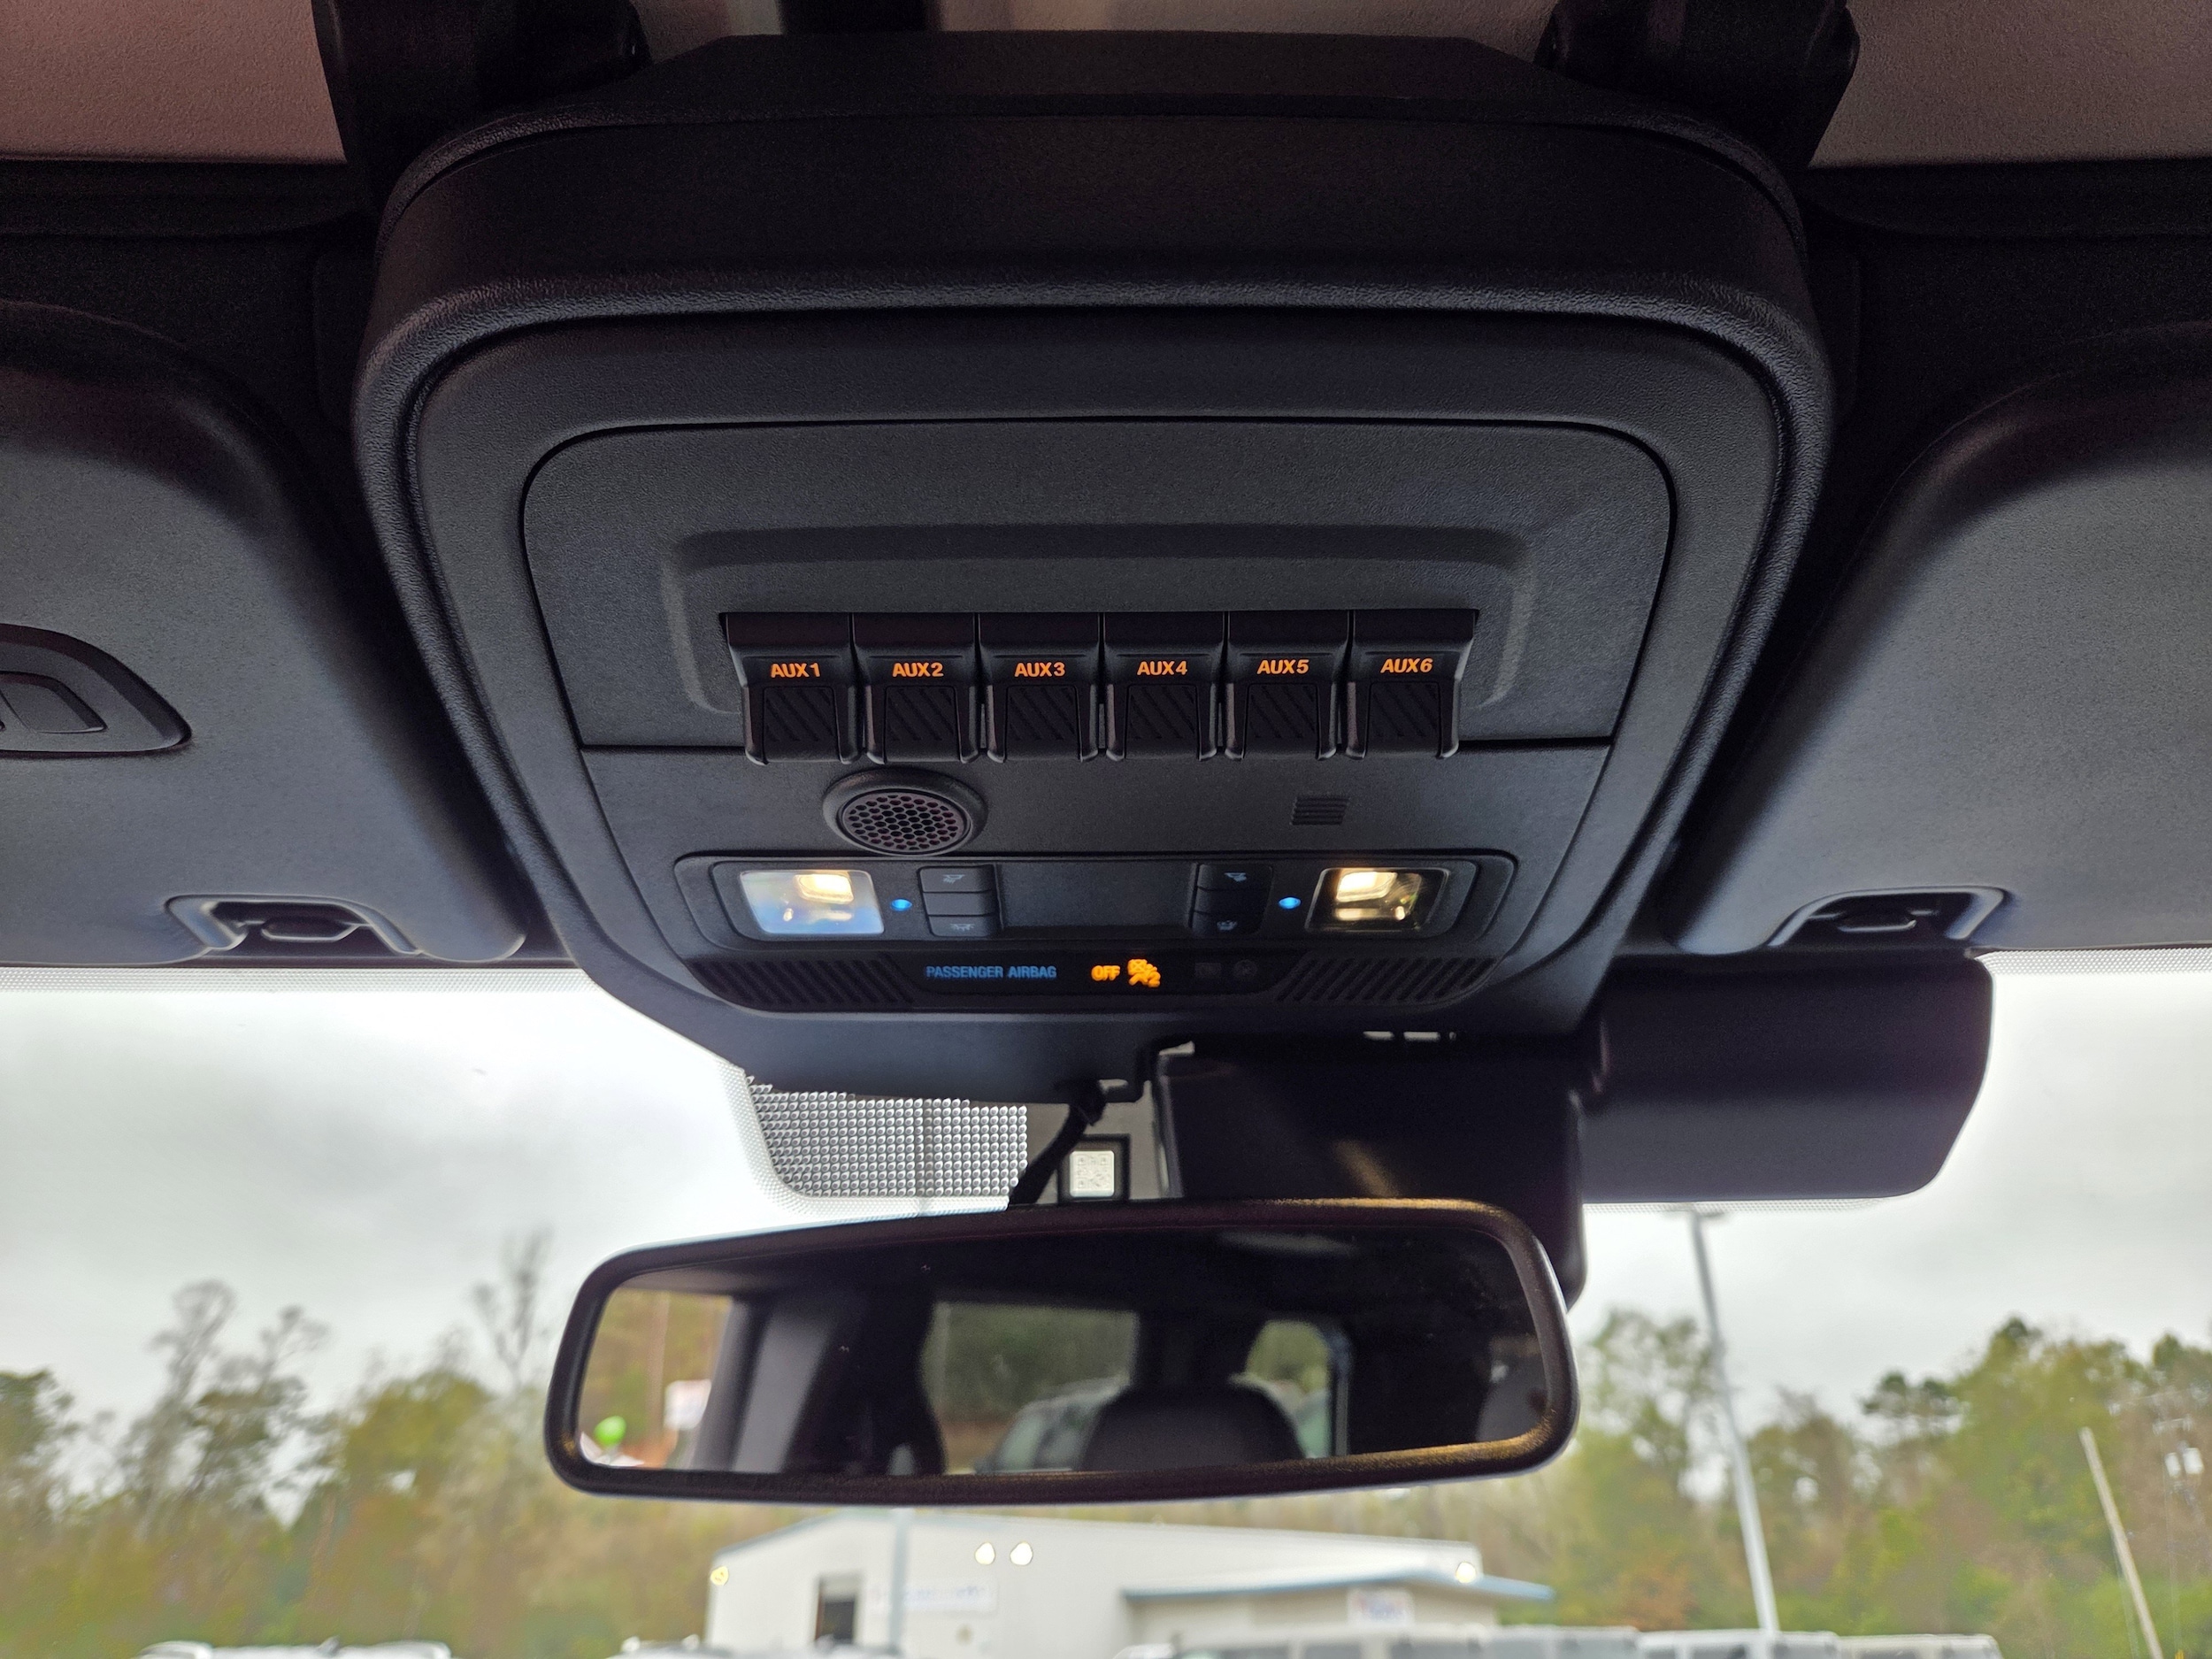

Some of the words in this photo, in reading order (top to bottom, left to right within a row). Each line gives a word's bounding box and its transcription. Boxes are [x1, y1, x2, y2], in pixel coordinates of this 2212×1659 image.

[771, 663, 820, 678] AUX1
[892, 662, 944, 678] AUX2
[1014, 662, 1065, 677] AUX3
[1137, 661, 1188, 675] AUX4
[1257, 659, 1310, 674] AUX5
[1380, 657, 1433, 673] AUX6
[926, 965, 1004, 979] PASSENGER
[1007, 965, 1057, 979] AIRBAG
[1091, 965, 1120, 981] OFF
